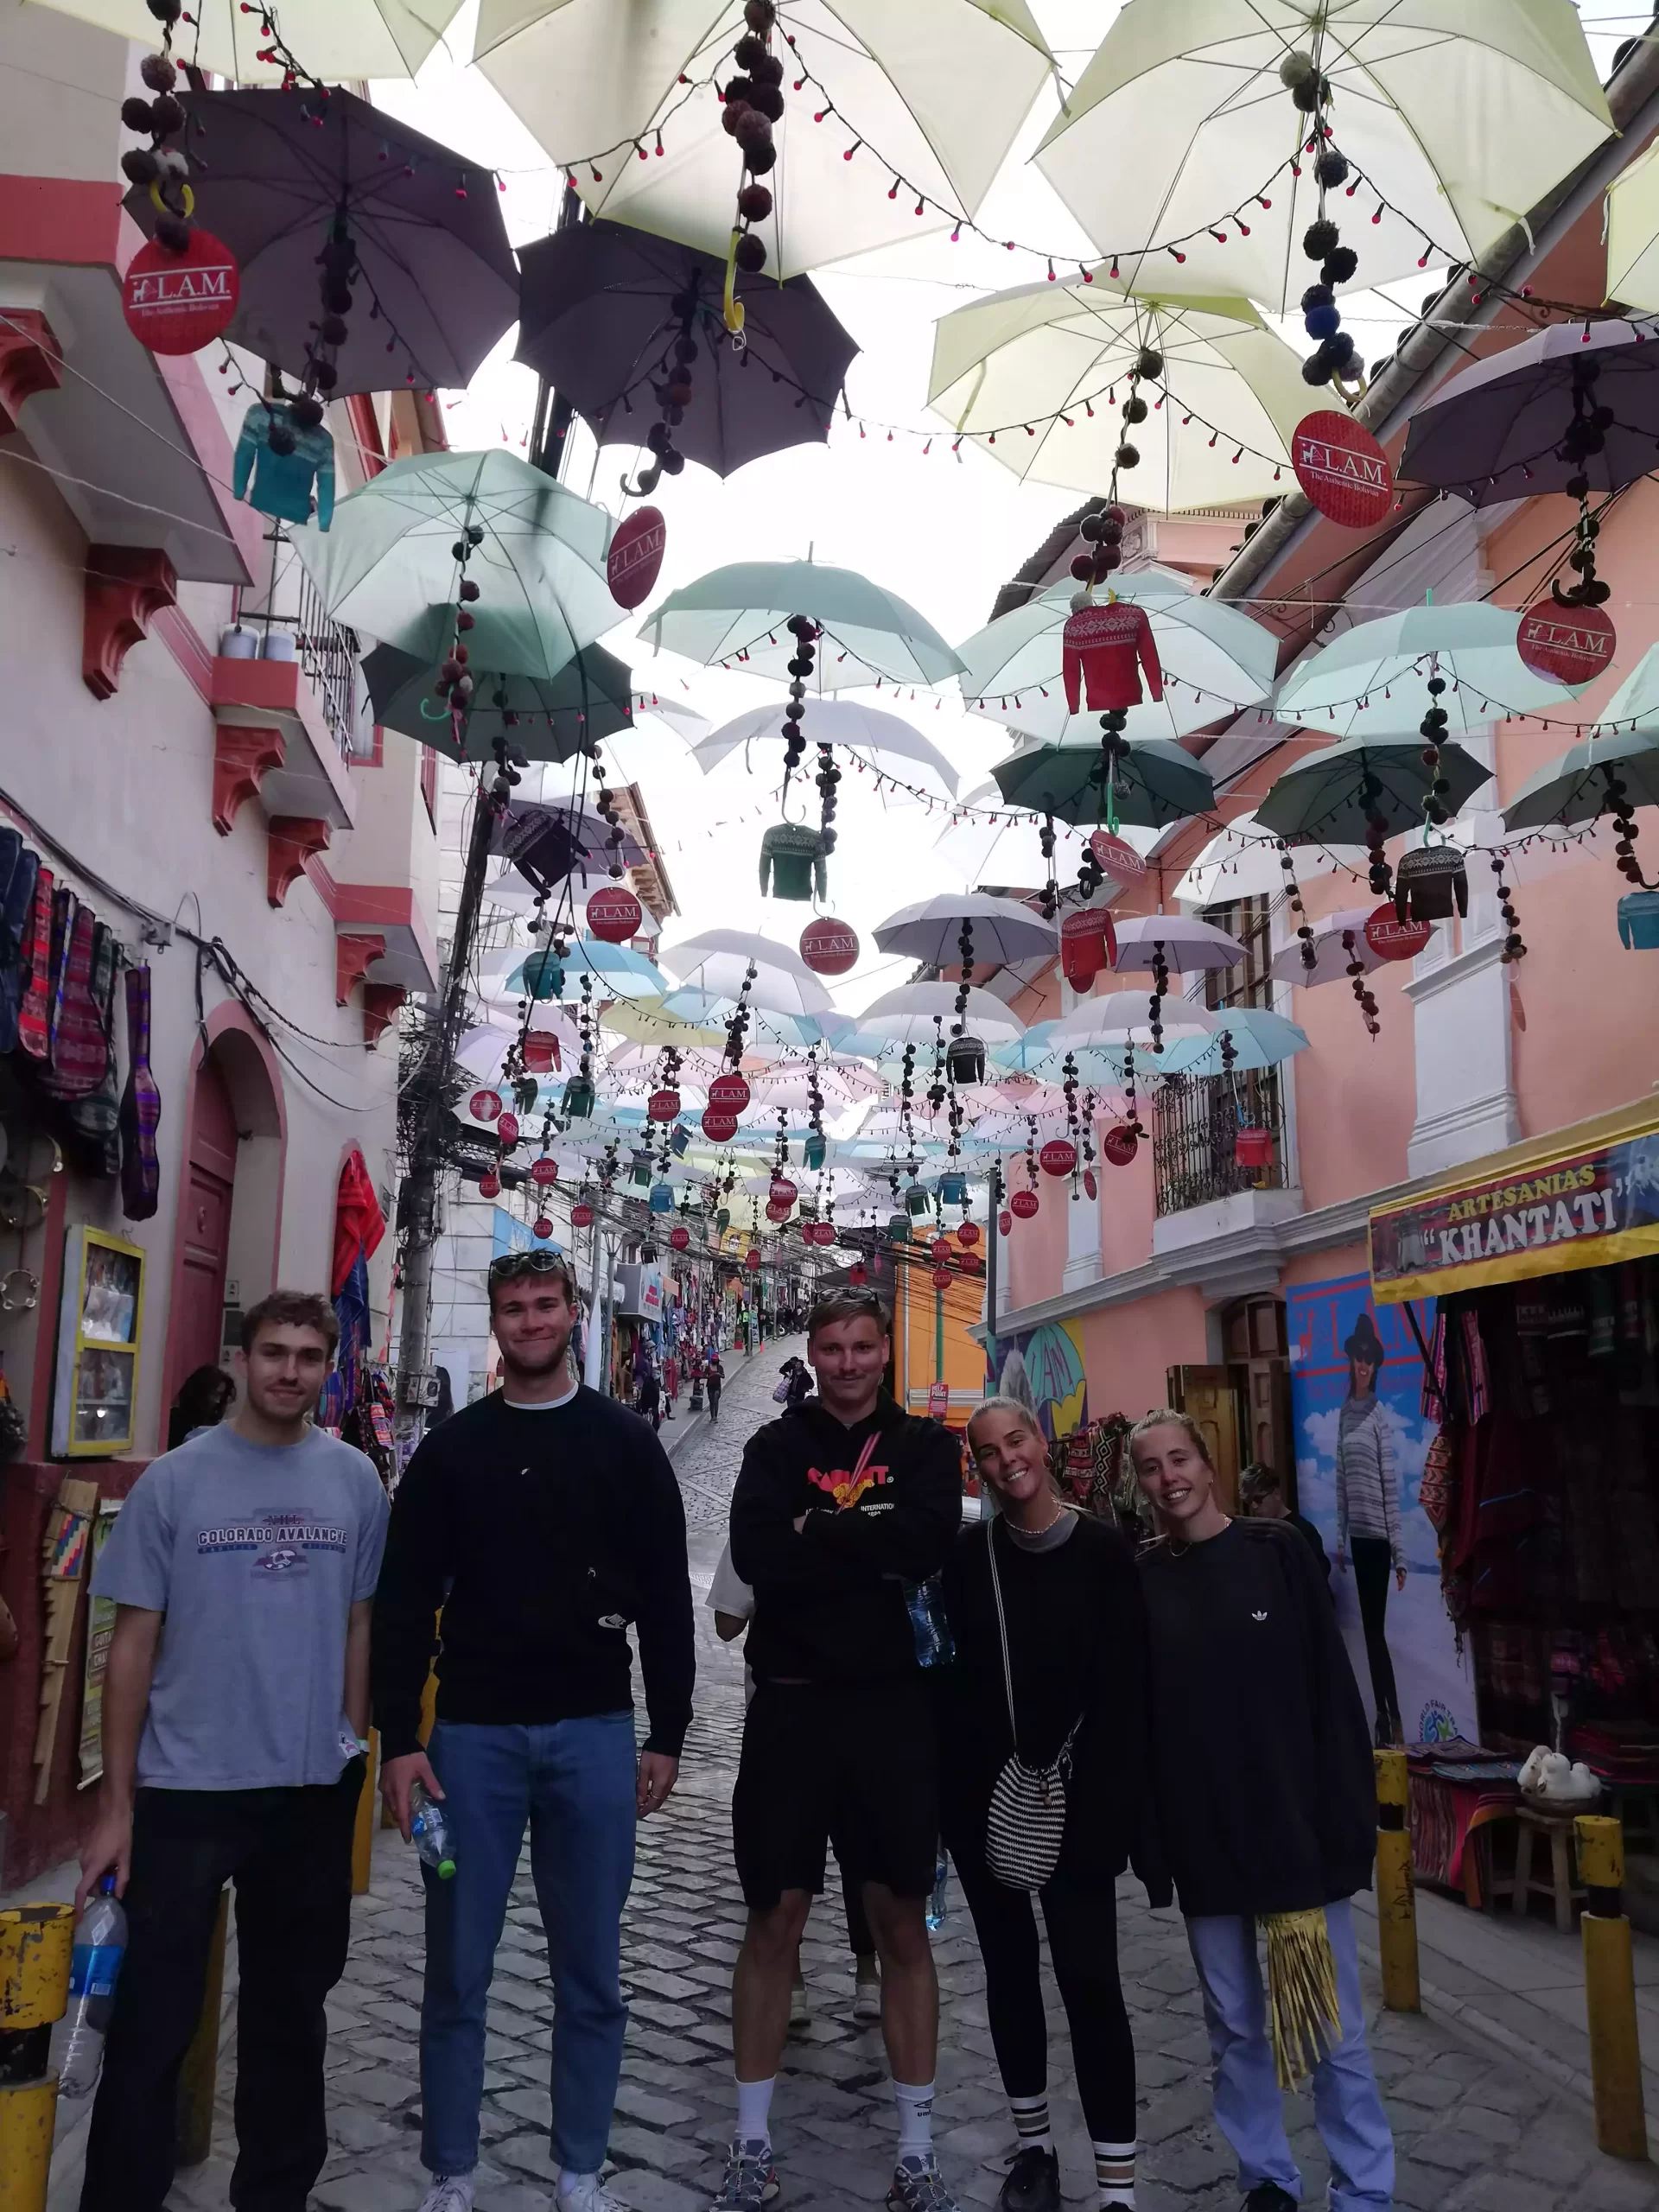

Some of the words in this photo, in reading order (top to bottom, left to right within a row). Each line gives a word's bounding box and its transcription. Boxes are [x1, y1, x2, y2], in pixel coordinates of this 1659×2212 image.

[157, 271, 231, 300] L.A.M.
[1324, 448, 1387, 486] L.A.M.
[1310, 471, 1323, 480] The
[1324, 474, 1353, 489] Authentic
[1354, 484, 1380, 498] Bolivian
[1548, 626, 1607, 653] L.A.M.
[1447, 1164, 1595, 1223] ARTESANIAS
[267, 1515, 301, 1526] NHL
[198, 1528, 273, 1546] COLORADO
[1430, 1700, 1446, 1711] FAIR
